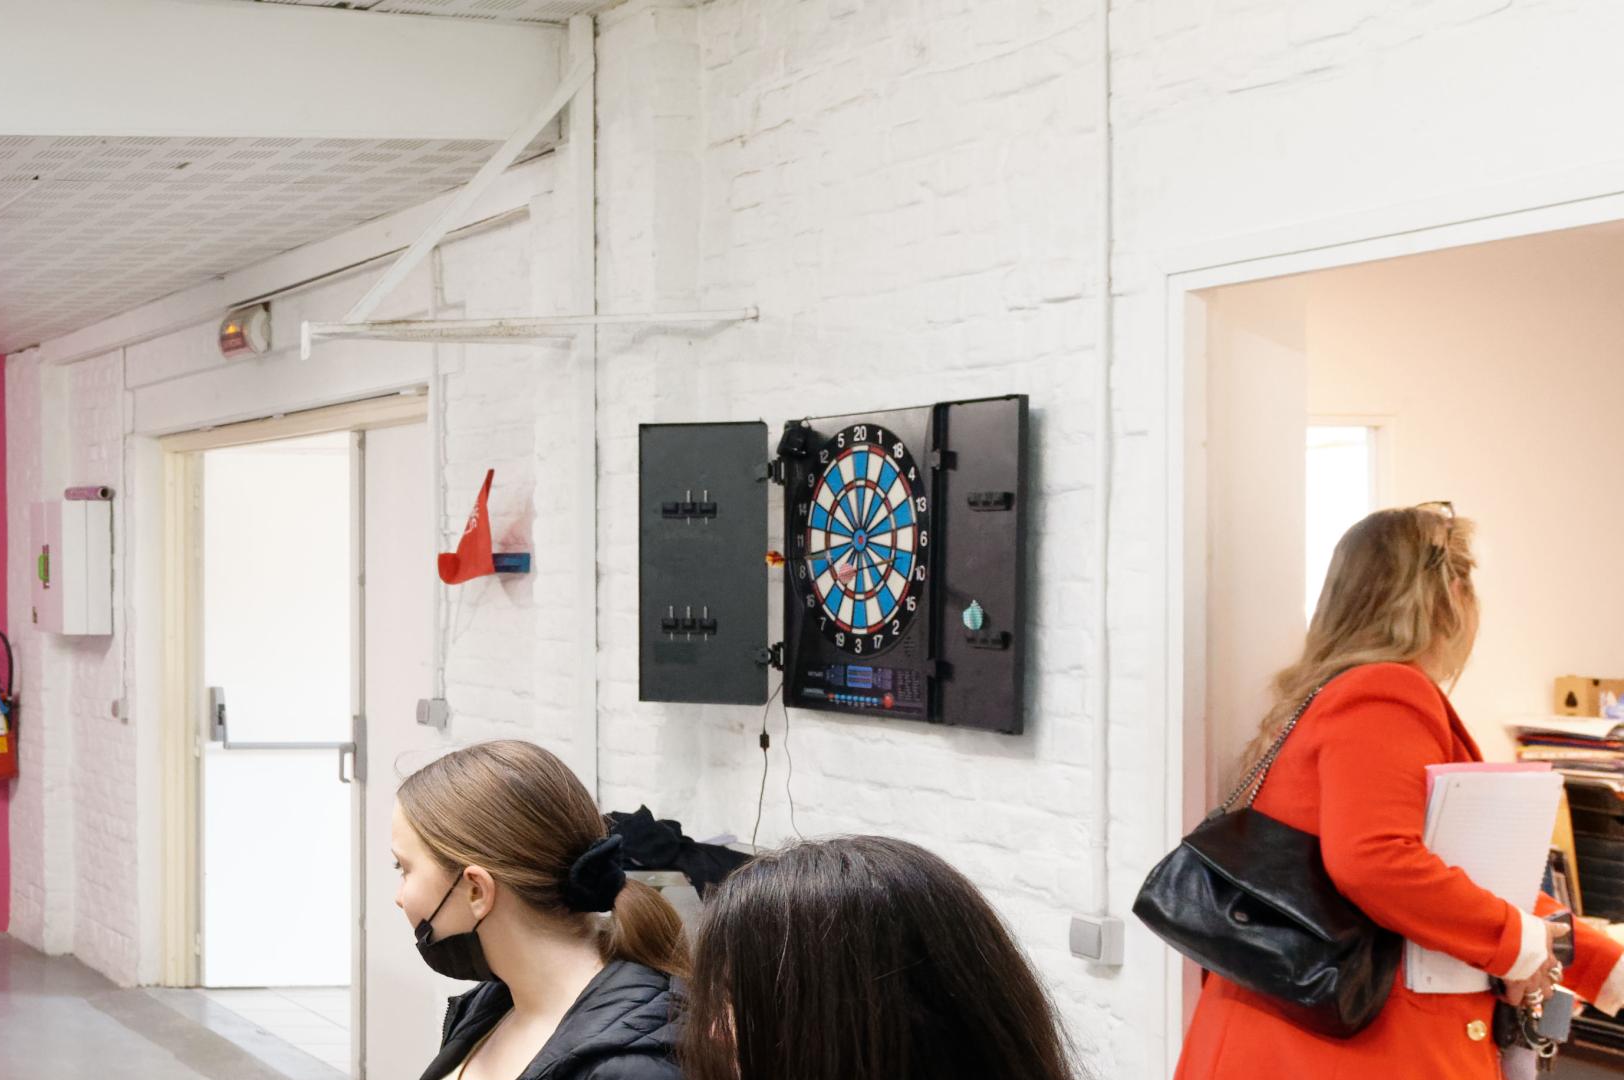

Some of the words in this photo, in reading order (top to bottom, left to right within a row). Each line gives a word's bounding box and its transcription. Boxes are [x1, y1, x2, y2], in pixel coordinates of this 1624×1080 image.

[837, 432, 846, 448] 5
[853, 425, 868, 442] 20
[877, 429, 883, 445] 1
[819, 449, 830, 464] 12
[892, 442, 905, 459] 18
[807, 473, 816, 488] 9
[907, 466, 916, 481] 4
[798, 502, 808, 517] 14
[916, 496, 928, 513] 13
[797, 534, 805, 548] 11
[919, 530, 929, 547] 6
[799, 564, 807, 580] 8
[914, 565, 926, 582] 10
[806, 594, 816, 609] 16
[905, 596, 917, 612] 15
[820, 617, 827, 632] 7
[892, 619, 901, 636] 2
[834, 632, 846, 648] 19
[854, 638, 863, 654] 3
[873, 634, 884, 649] 17
